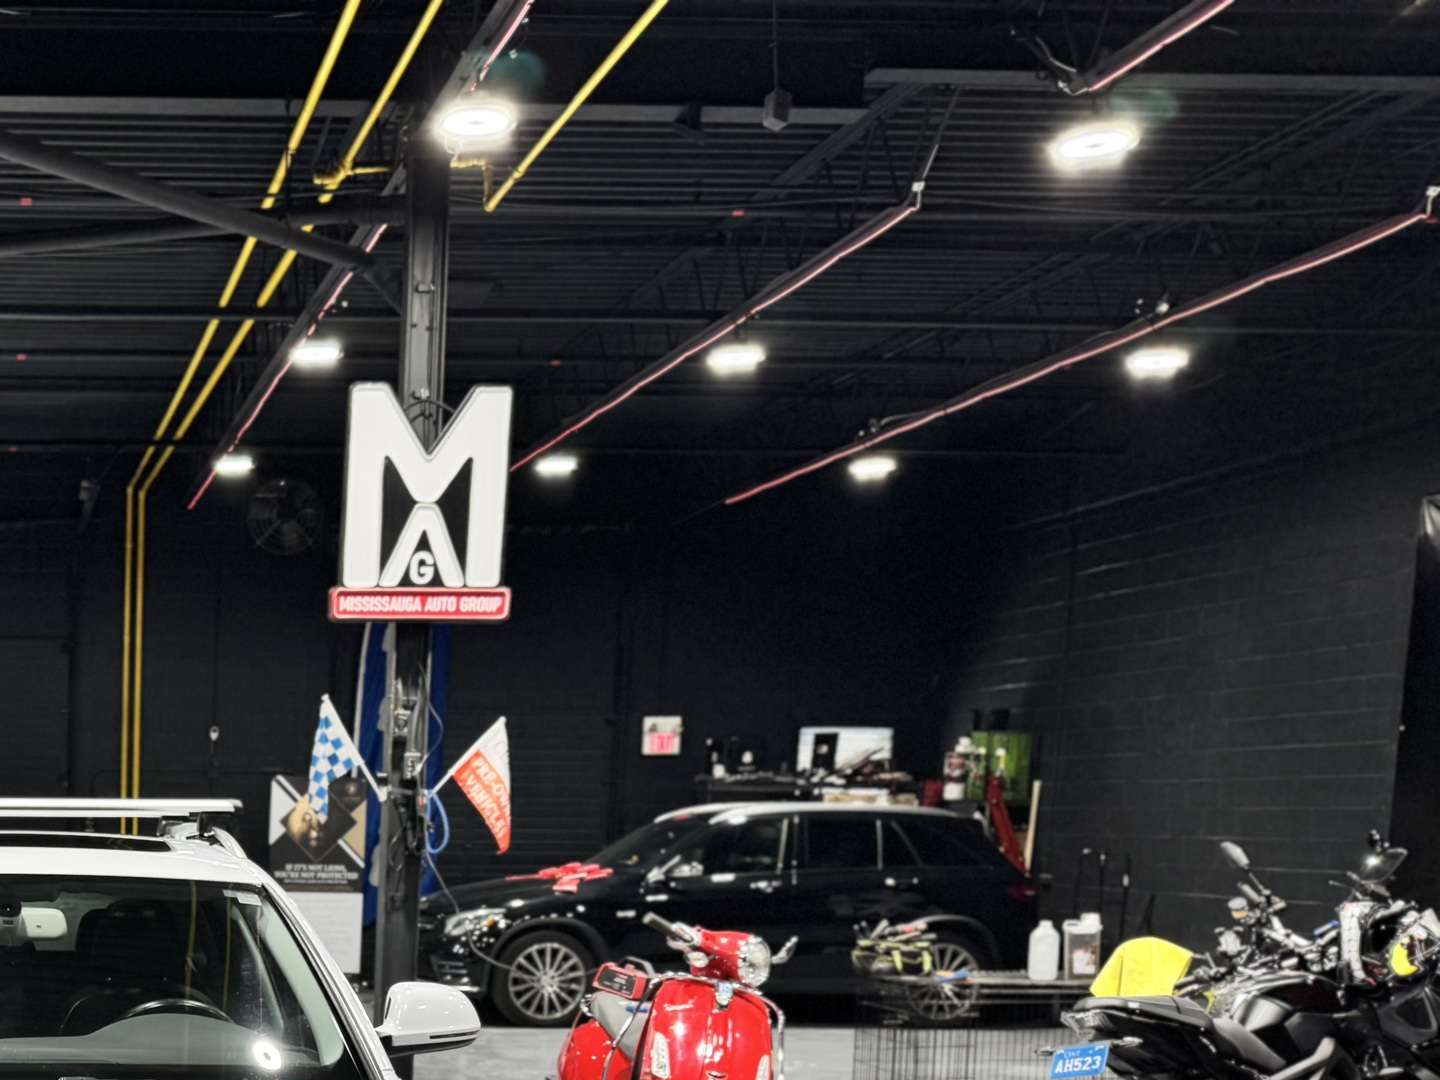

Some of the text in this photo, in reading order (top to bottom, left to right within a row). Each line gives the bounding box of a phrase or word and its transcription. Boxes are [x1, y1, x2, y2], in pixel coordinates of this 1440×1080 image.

[338, 595, 503, 614] MISSISSAUGA AUTO GROUP
[1055, 1056, 1101, 1073] AH523
